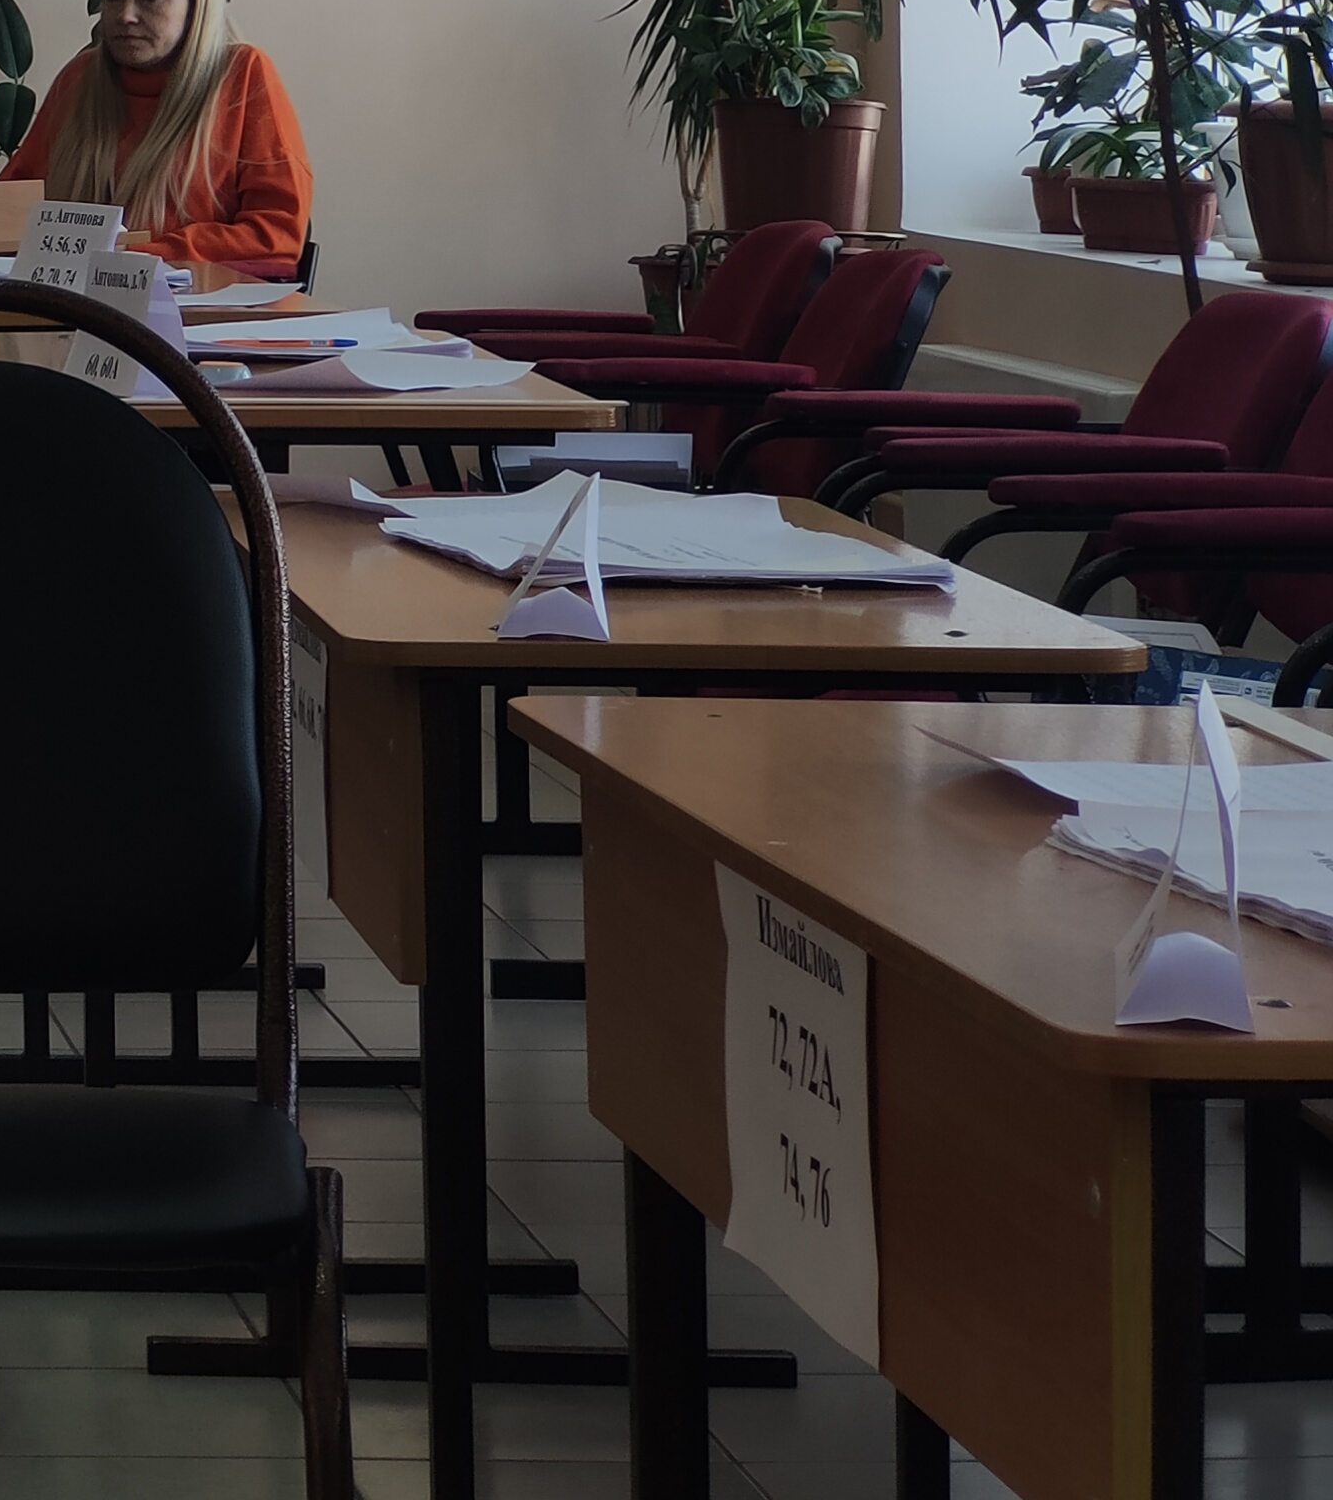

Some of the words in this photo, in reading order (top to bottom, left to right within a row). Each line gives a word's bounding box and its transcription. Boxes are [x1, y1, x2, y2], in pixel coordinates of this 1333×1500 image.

[54, 208, 105, 227] Антонова
[39, 235, 53, 254] 54,
[55, 236, 71, 256] 56,
[72, 238, 87, 255] 58
[63, 270, 78, 286] 74
[84, 353, 100, 379] 60,
[100, 354, 119, 380] 60А
[756, 894, 845, 997] Измайлова
[768, 1004, 794, 1091] 72,
[799, 1024, 842, 1125] 72А,
[780, 1132, 806, 1222] 74,
[810, 1155, 831, 1230] 76
